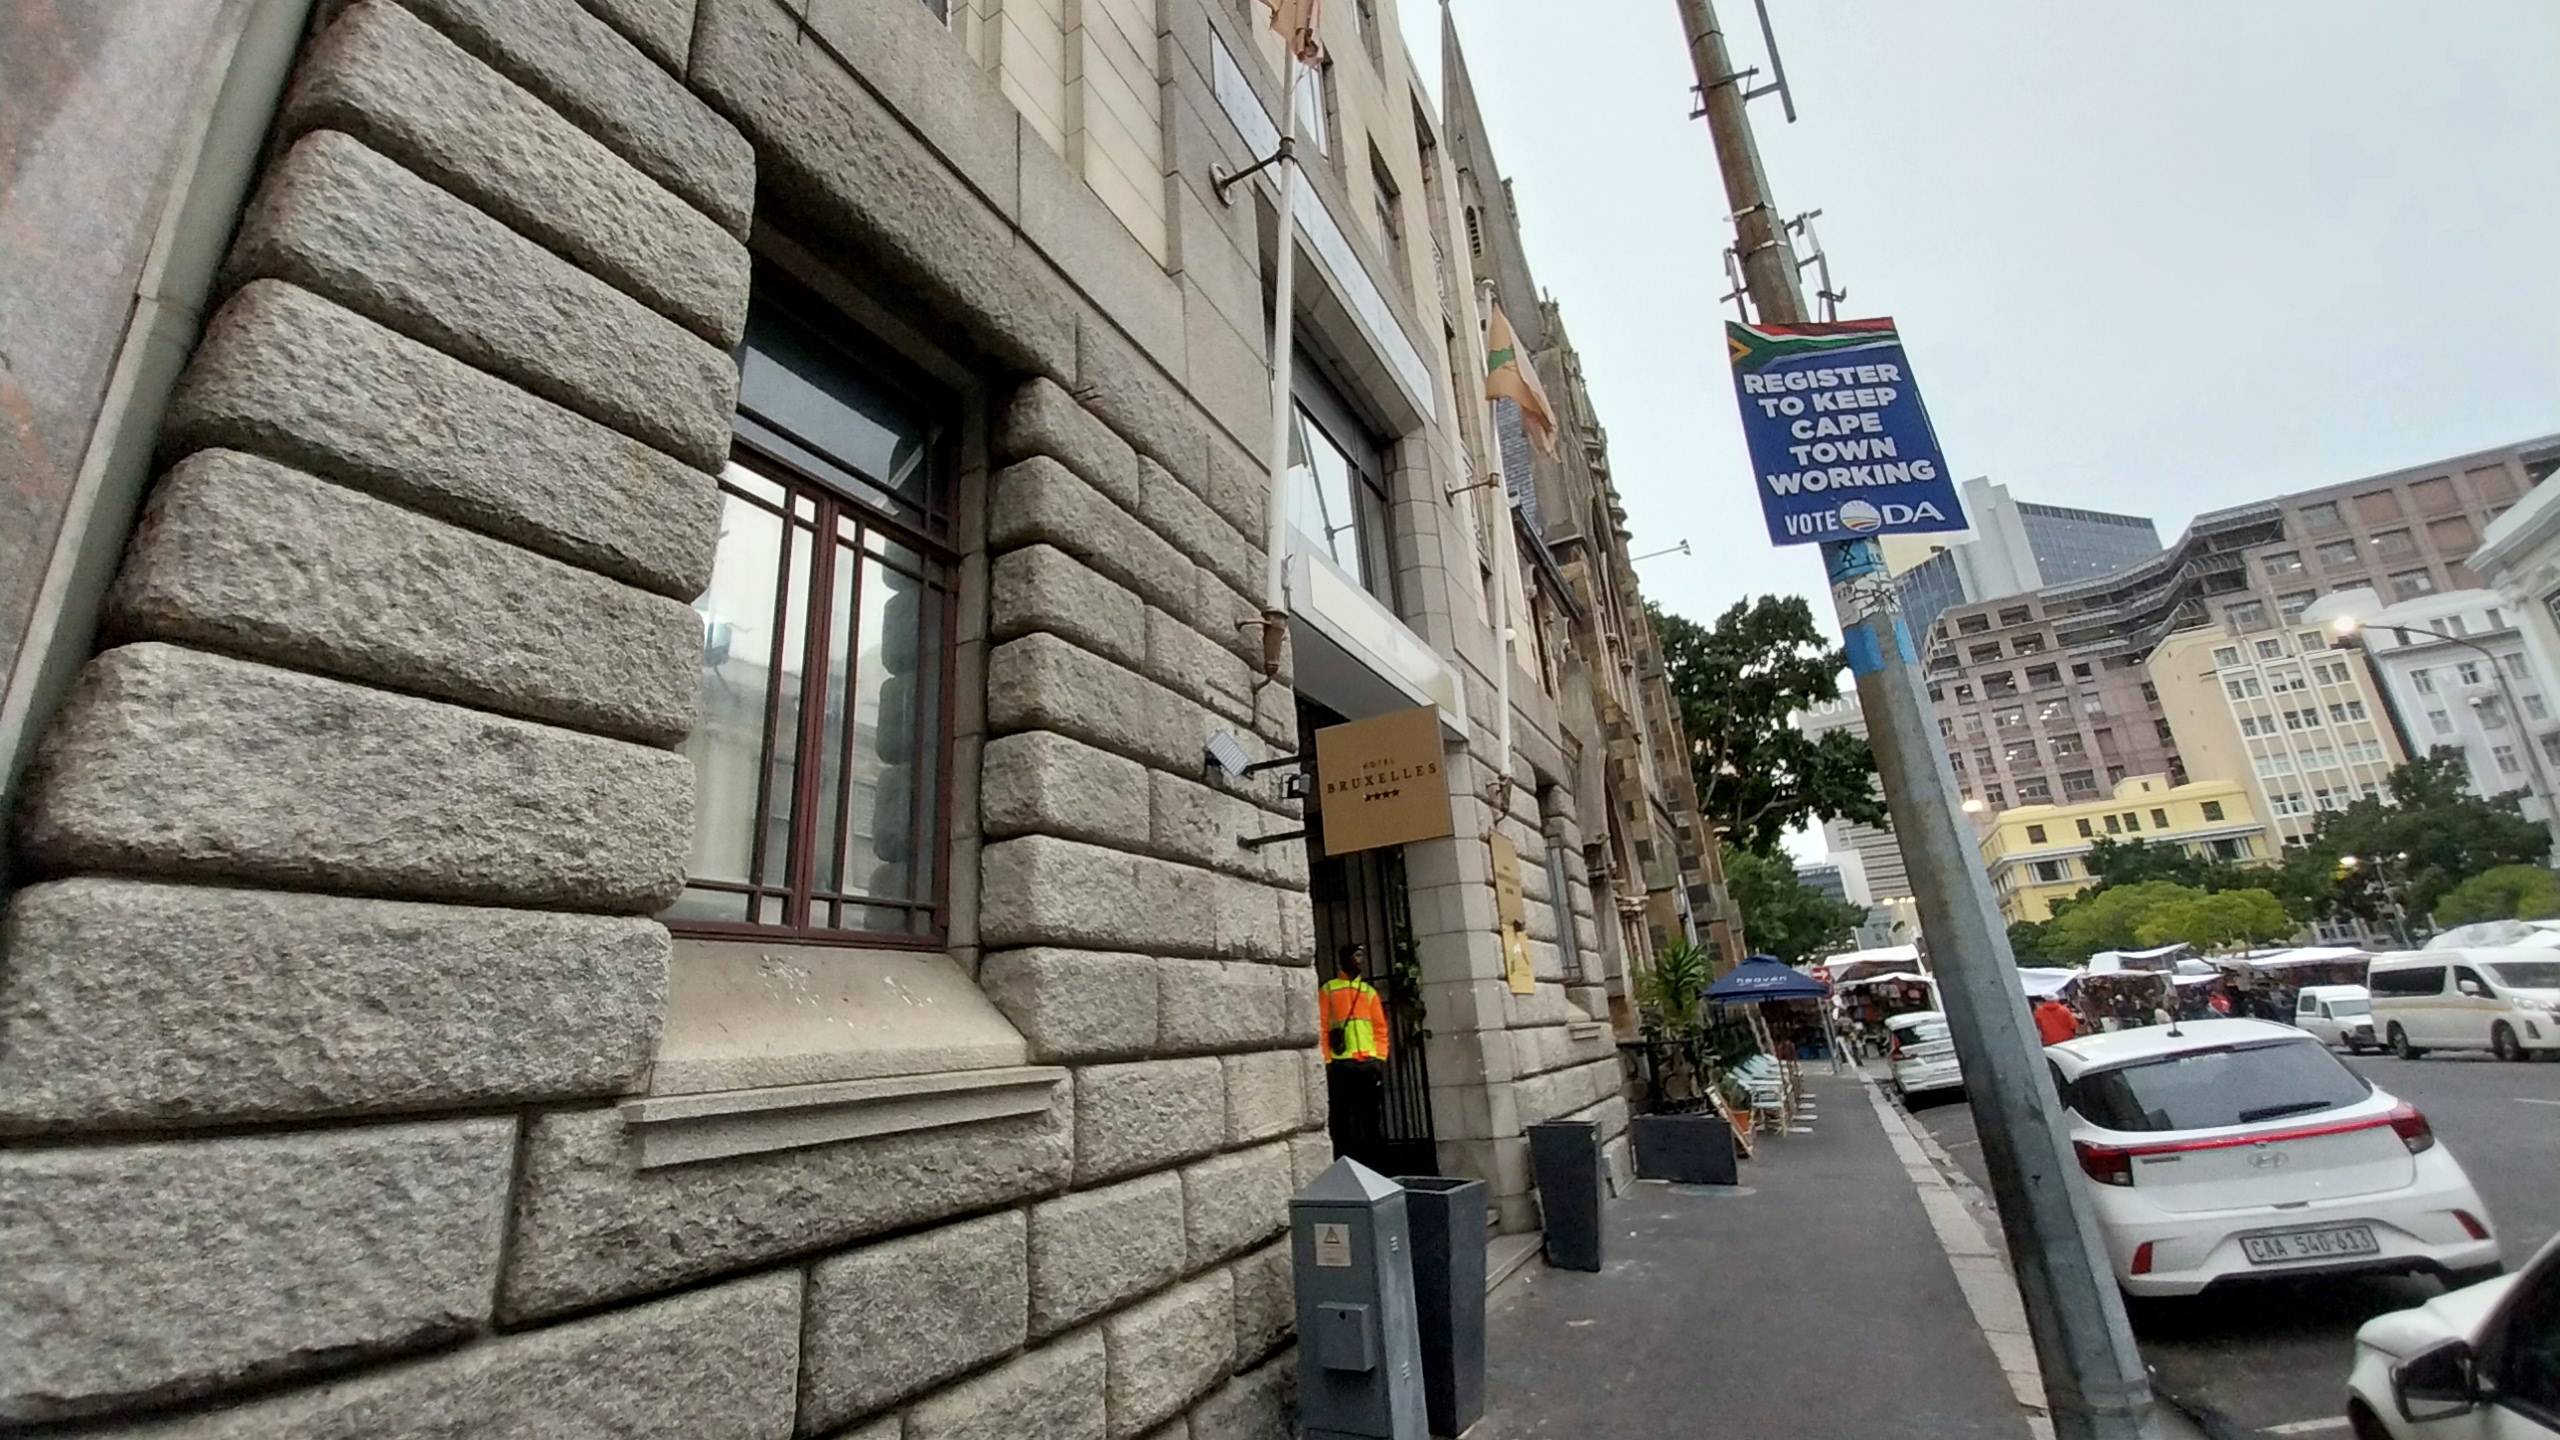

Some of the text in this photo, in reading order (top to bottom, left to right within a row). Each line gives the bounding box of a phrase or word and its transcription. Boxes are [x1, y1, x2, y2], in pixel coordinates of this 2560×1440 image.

[1743, 363, 1901, 395] REGISTER
[1757, 387, 1898, 419] TO KEEP
[1791, 412, 1884, 440] CAPE
[1789, 437, 1897, 467] TOWN
[1767, 459, 1936, 496] WORKING
[1785, 501, 1946, 537] VOTE DA
[1326, 762, 1438, 795] BRUXELLES
[1363, 758, 1395, 770] HOTEL
[2251, 1237, 2289, 1259] CAA
